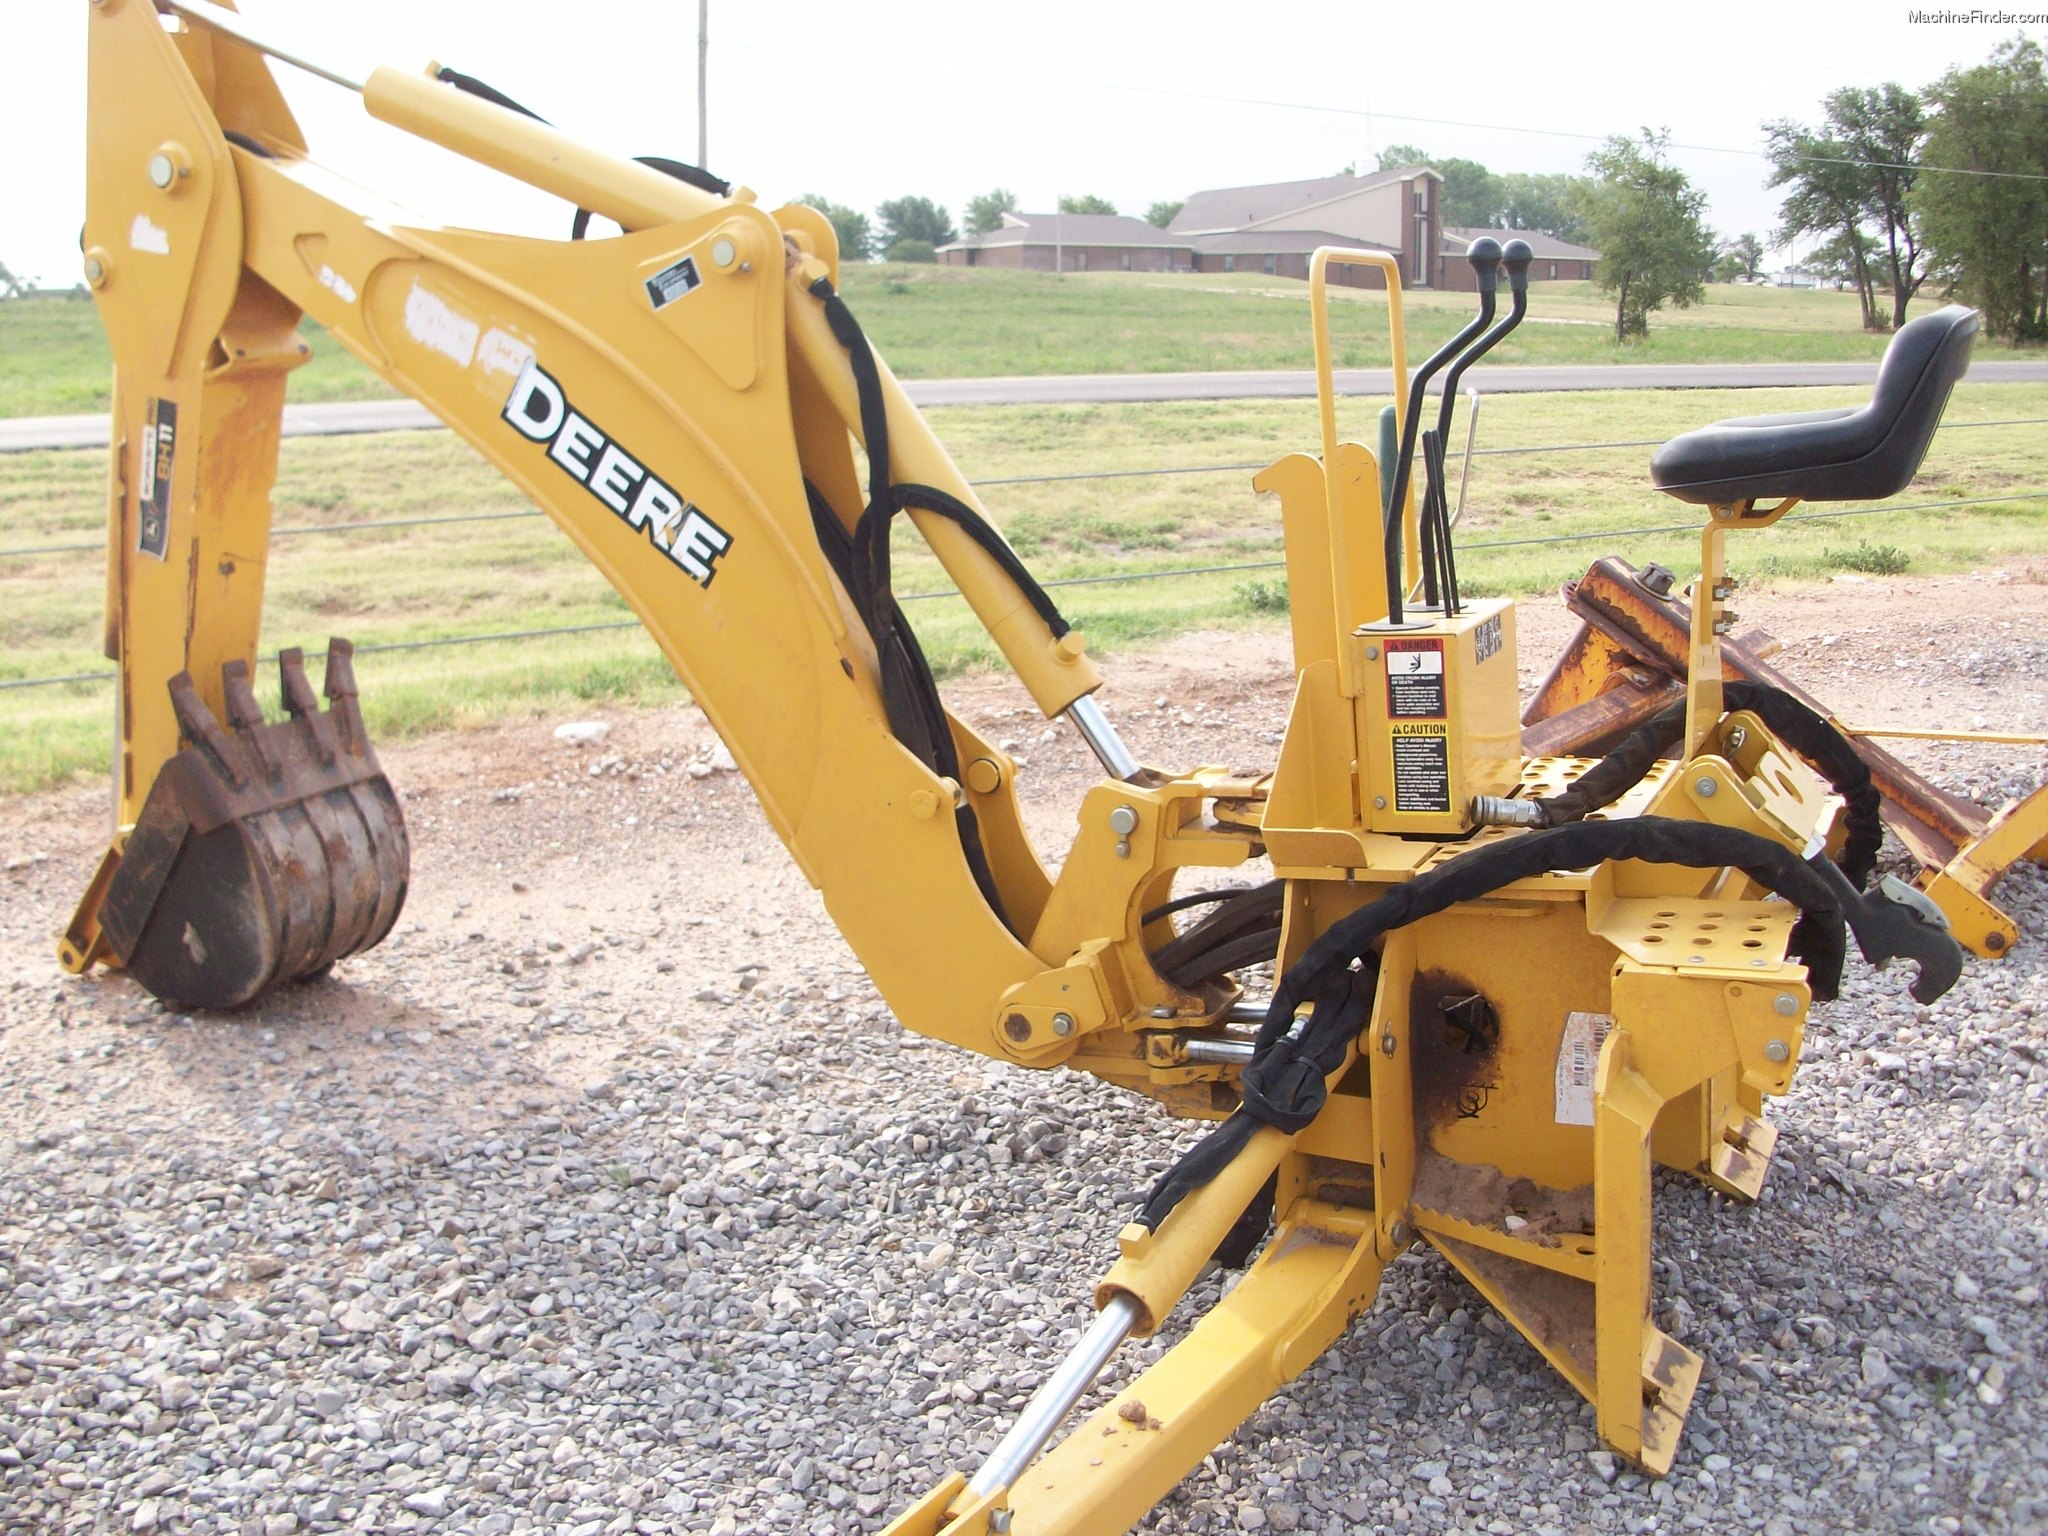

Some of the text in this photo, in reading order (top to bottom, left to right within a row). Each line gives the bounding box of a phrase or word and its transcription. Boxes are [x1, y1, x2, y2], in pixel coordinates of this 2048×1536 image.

[156, 422, 173, 481] BH11
[502, 360, 733, 589] DEERE
[1401, 639, 1438, 650] DANGER
[1402, 724, 1446, 735] CAUTION
